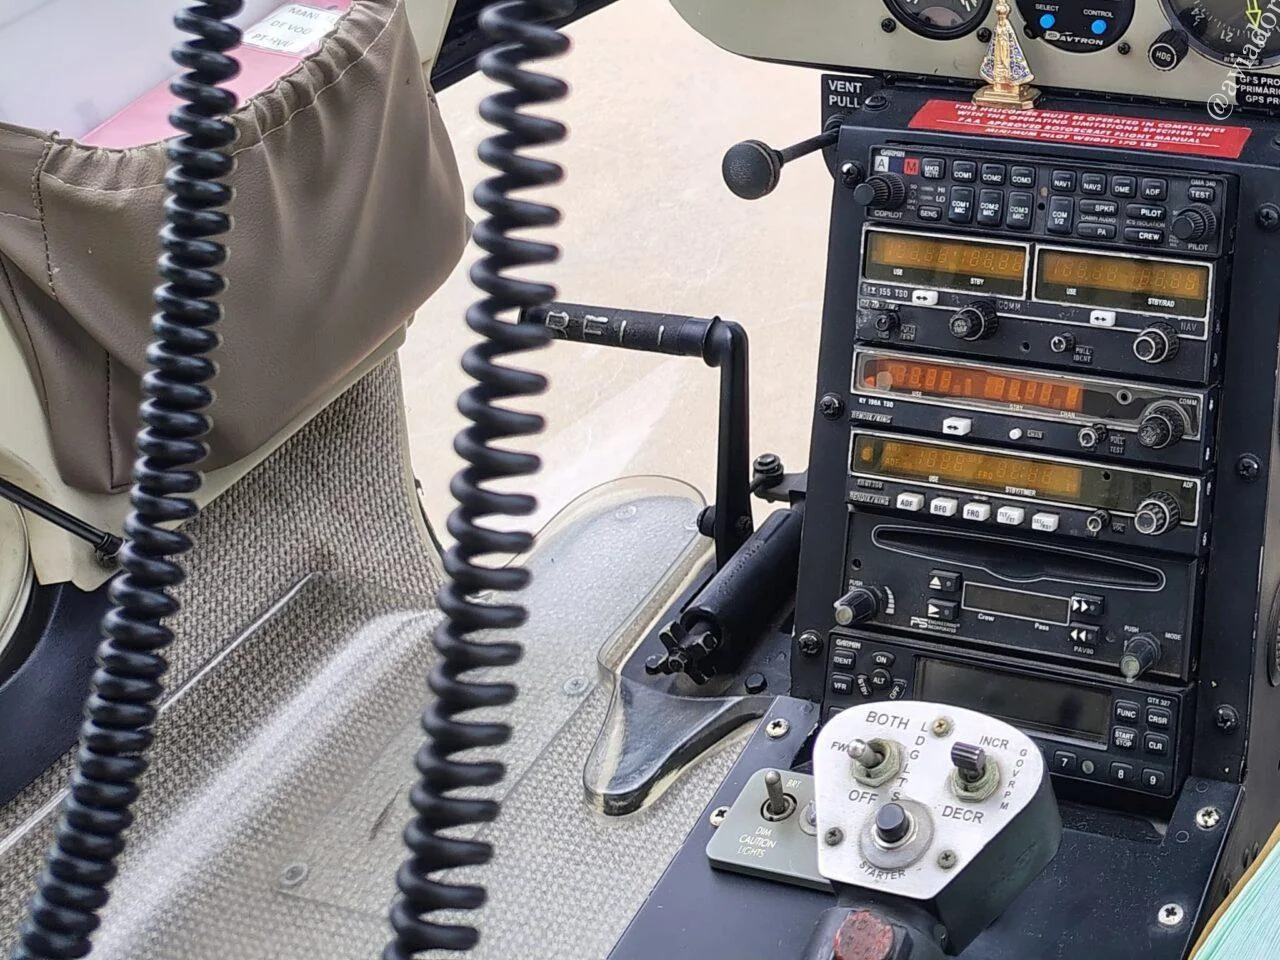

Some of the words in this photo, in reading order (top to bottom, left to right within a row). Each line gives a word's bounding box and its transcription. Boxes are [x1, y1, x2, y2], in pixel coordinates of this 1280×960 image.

[1083, 9, 1113, 17] CONTROL
[1156, 51, 1171, 61] HDG
[829, 80, 862, 93] VENT
[829, 95, 860, 108] PULL
[1246, 95, 1264, 103] GPS
[954, 171, 971, 179] COM1
[1012, 176, 1031, 184] COM3
[1084, 183, 1101, 191] NAV2
[1141, 209, 1161, 217] PILOT
[1139, 232, 1159, 240] CREW
[1110, 446, 1123, 454] TEST
[978, 613, 994, 621] Crew
[834, 682, 846, 690] VFR
[1117, 710, 1136, 718] FUNC
[866, 711, 910, 730] BOTH
[1148, 716, 1168, 724] CRSR
[1115, 731, 1134, 739] START
[979, 735, 1009, 749] INCR
[1116, 738, 1131, 747] STOP
[1149, 742, 1162, 750] CLR
[1062, 758, 1067, 766] 7
[1118, 770, 1124, 779] 8
[1150, 776, 1156, 784] 9
[849, 790, 878, 803] OFF
[942, 806, 984, 824] DECR
[755, 826, 772, 836] DIM
[739, 835, 776, 848] CAUTION
[737, 846, 766, 858] LIGHTS
[859, 861, 906, 879] STARTER
